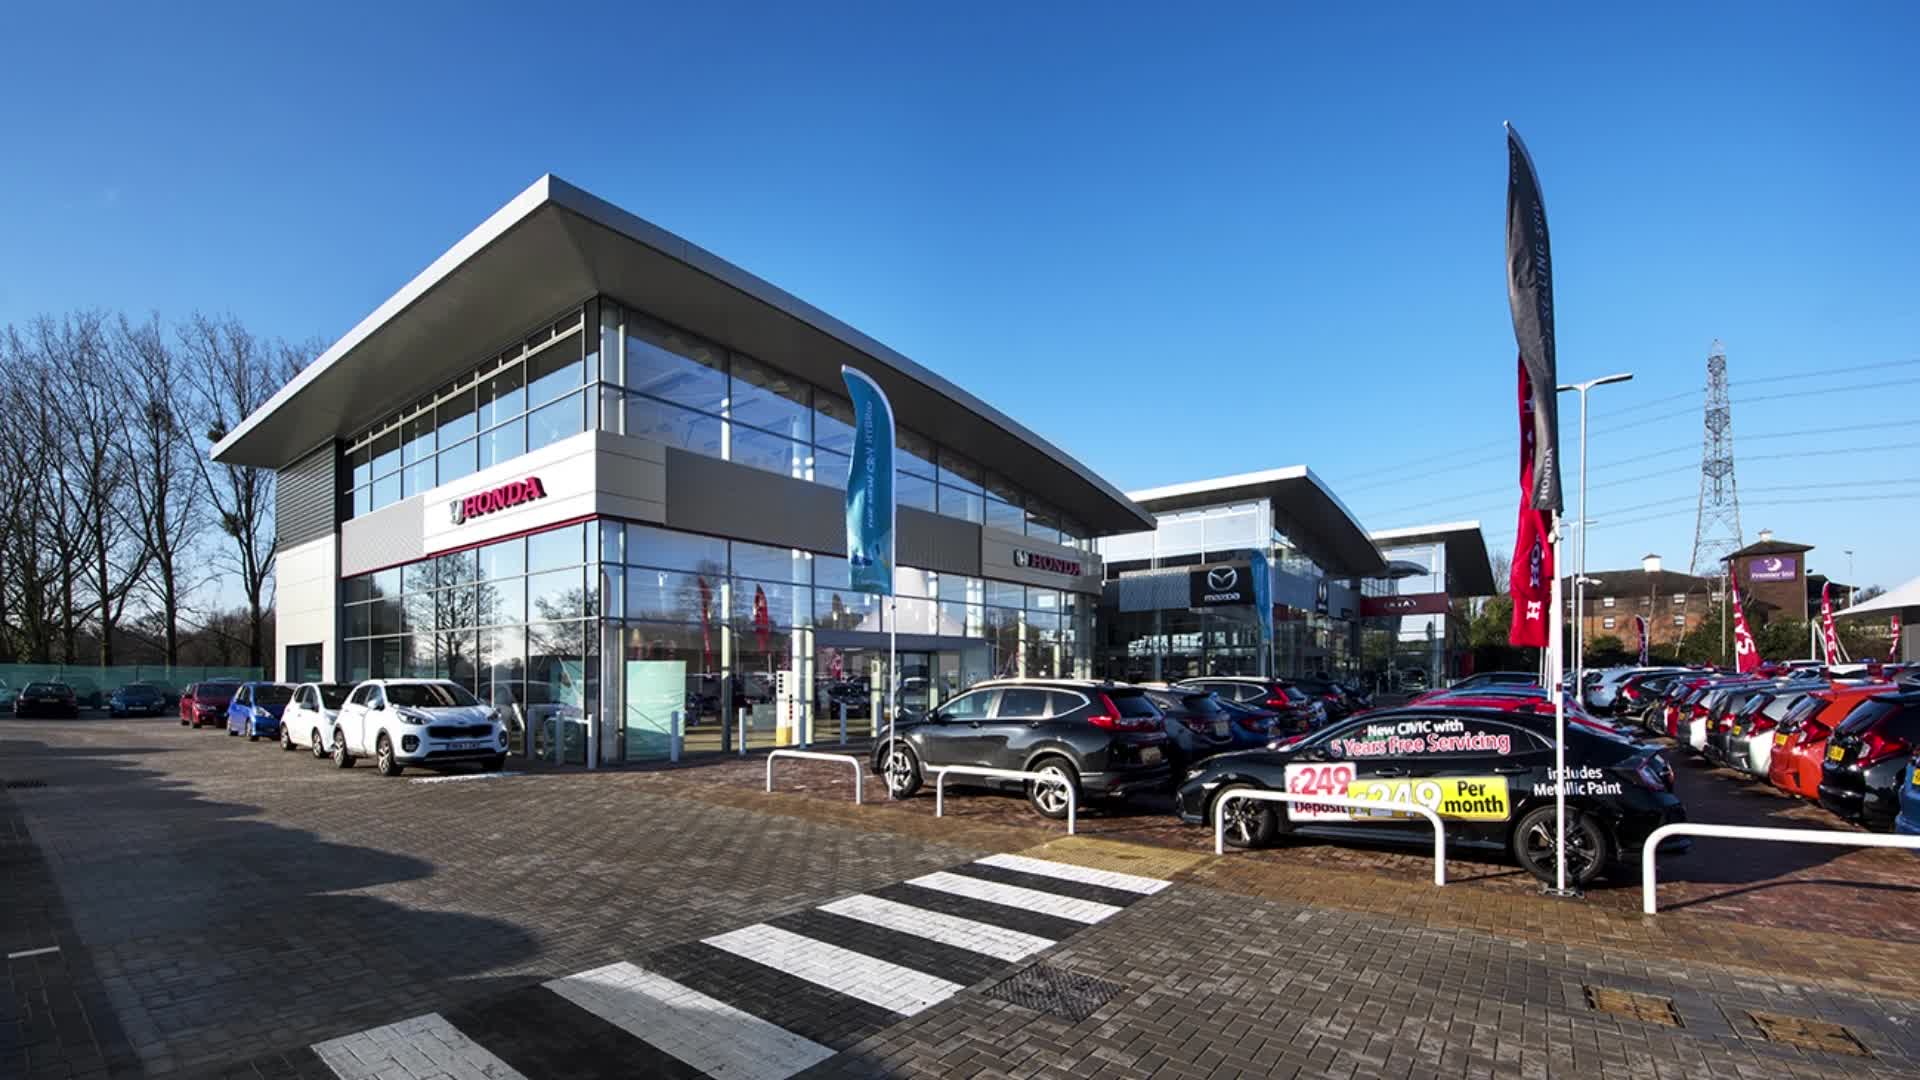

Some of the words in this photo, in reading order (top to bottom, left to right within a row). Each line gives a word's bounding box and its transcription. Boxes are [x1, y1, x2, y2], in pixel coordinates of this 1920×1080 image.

[1540, 448, 1553, 500] HONDA
[463, 476, 546, 518] HONDA
[1032, 552, 1086, 576] HONDA
[1367, 725, 1395, 737] New
[1397, 720, 1431, 735] CIVIC
[1433, 719, 1464, 733] with
[1343, 738, 1387, 756] Years
[1388, 736, 1425, 754] Free
[1427, 731, 1511, 755] Servicing
[1290, 766, 1352, 796] £249
[1457, 781, 1486, 797] Per
[1533, 781, 1586, 797] Metllic
[1587, 781, 1622, 795] Paint
[1444, 795, 1504, 813] month
